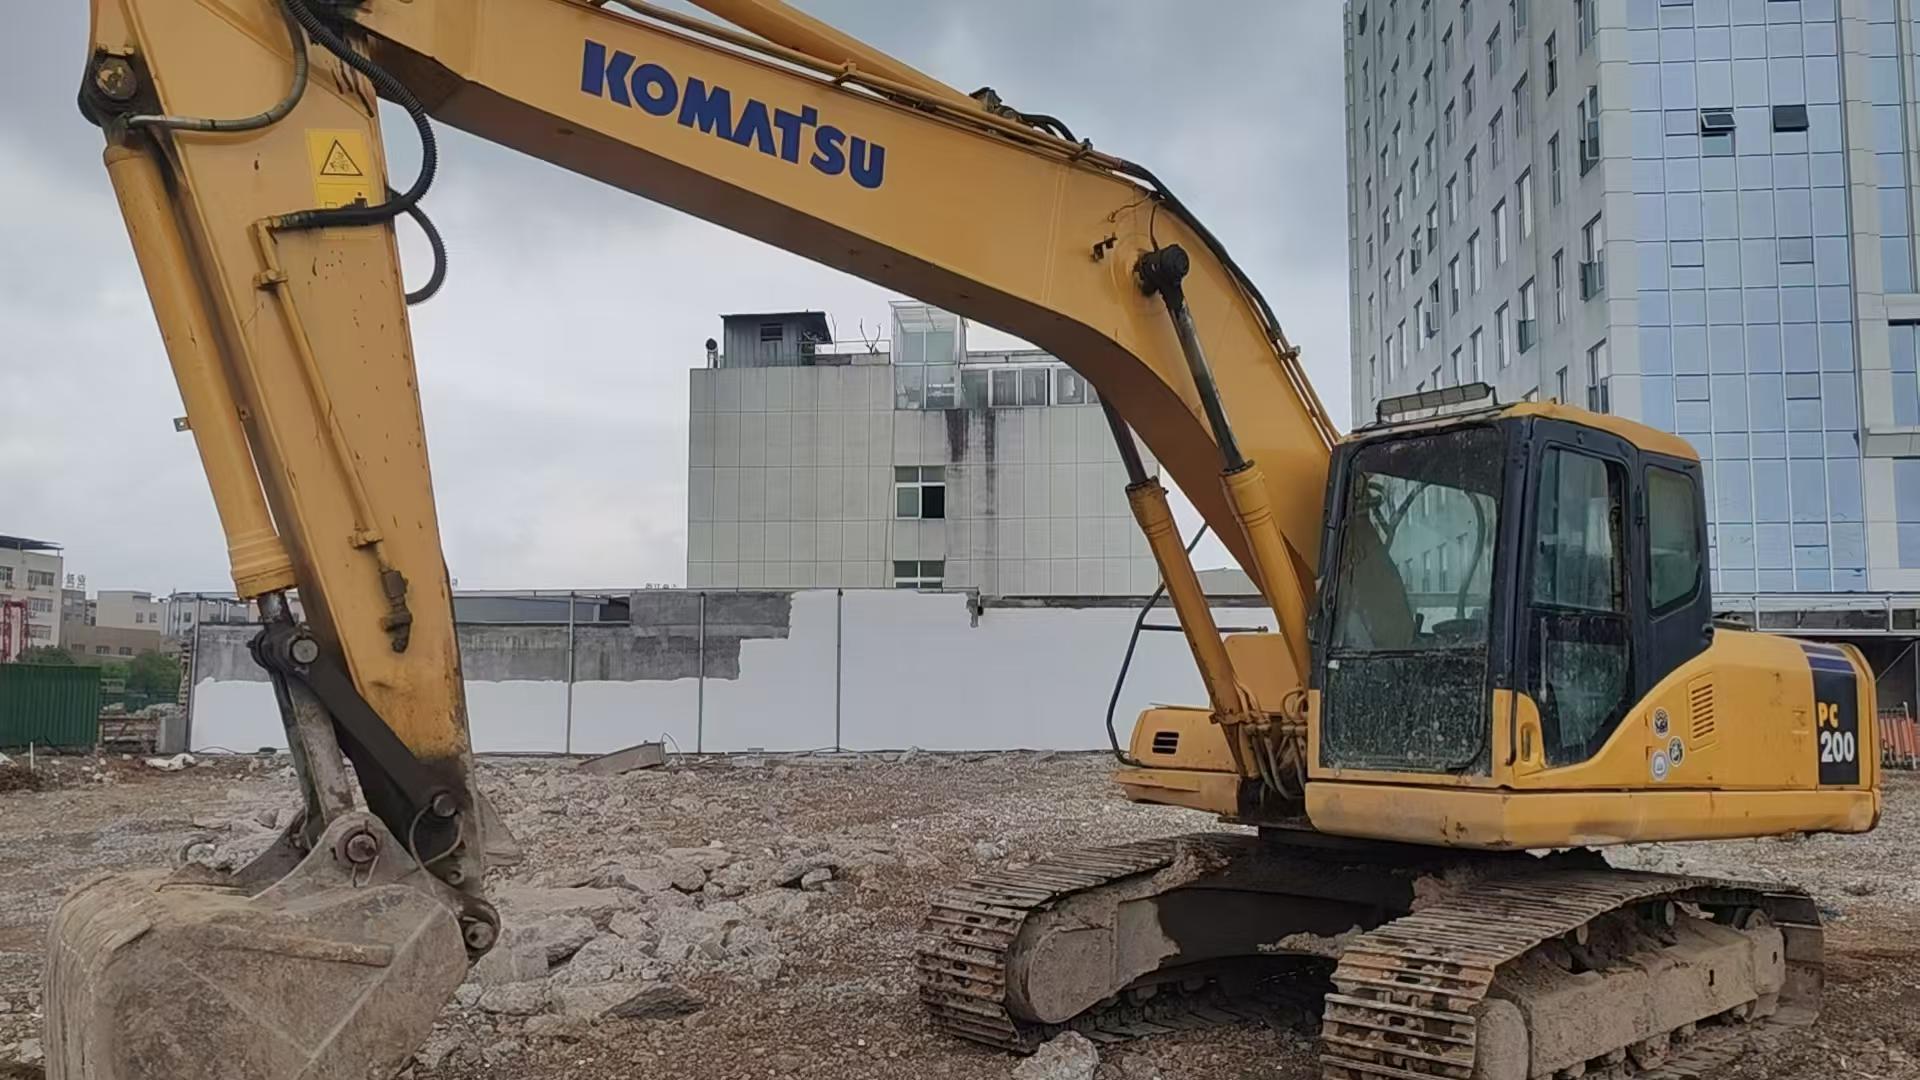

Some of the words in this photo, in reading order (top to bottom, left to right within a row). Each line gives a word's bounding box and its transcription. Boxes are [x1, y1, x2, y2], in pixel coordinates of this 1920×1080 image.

[581, 39, 885, 188] KOMATSU
[1818, 702, 1839, 728] PC
[1821, 731, 1854, 762] 200
